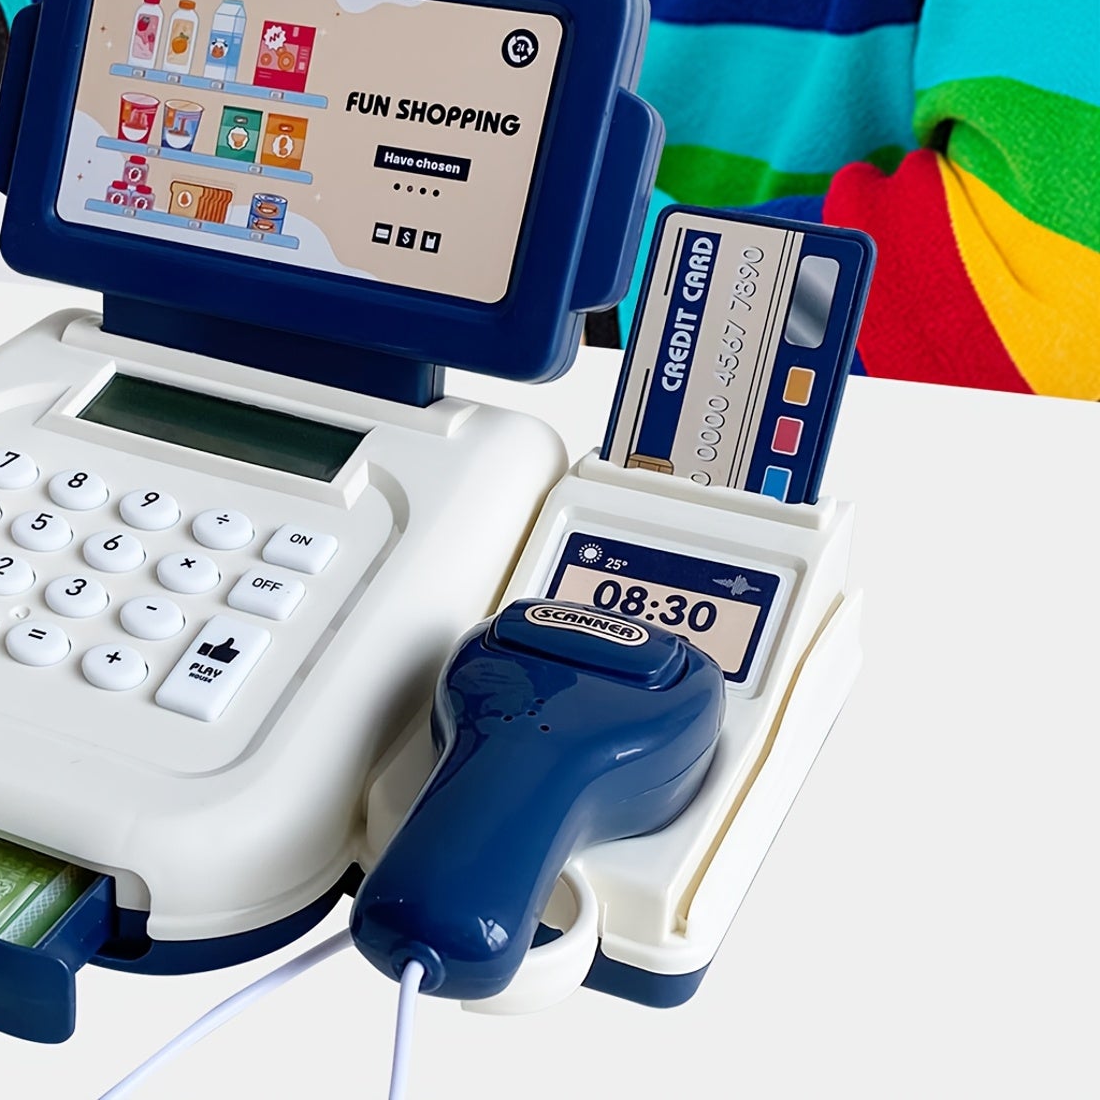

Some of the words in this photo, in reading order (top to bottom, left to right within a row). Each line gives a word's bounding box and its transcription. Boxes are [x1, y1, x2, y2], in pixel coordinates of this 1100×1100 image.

[345, 91, 391, 117] FUN
[395, 99, 521, 136] SHOPPING
[384, 151, 414, 168] Have
[415, 157, 461, 174] chosen
[729, 246, 765, 311] 7890
[661, 307, 697, 392] CREDIT
[682, 236, 714, 302] CARD
[715, 320, 747, 388] 4567
[697, 394, 729, 462] 0000
[0, 451, 20, 468] 7
[67, 472, 88, 488] 8
[140, 492, 160, 507] 9
[30, 513, 53, 531] 5
[103, 534, 123, 551] 6
[289, 533, 313, 546] ON
[65, 578, 87, 596] 3
[252, 577, 283, 592] OFF
[593, 579, 717, 632] 08:30
[537, 609, 636, 639] SCANNER
[189, 662, 223, 678] PLAY
